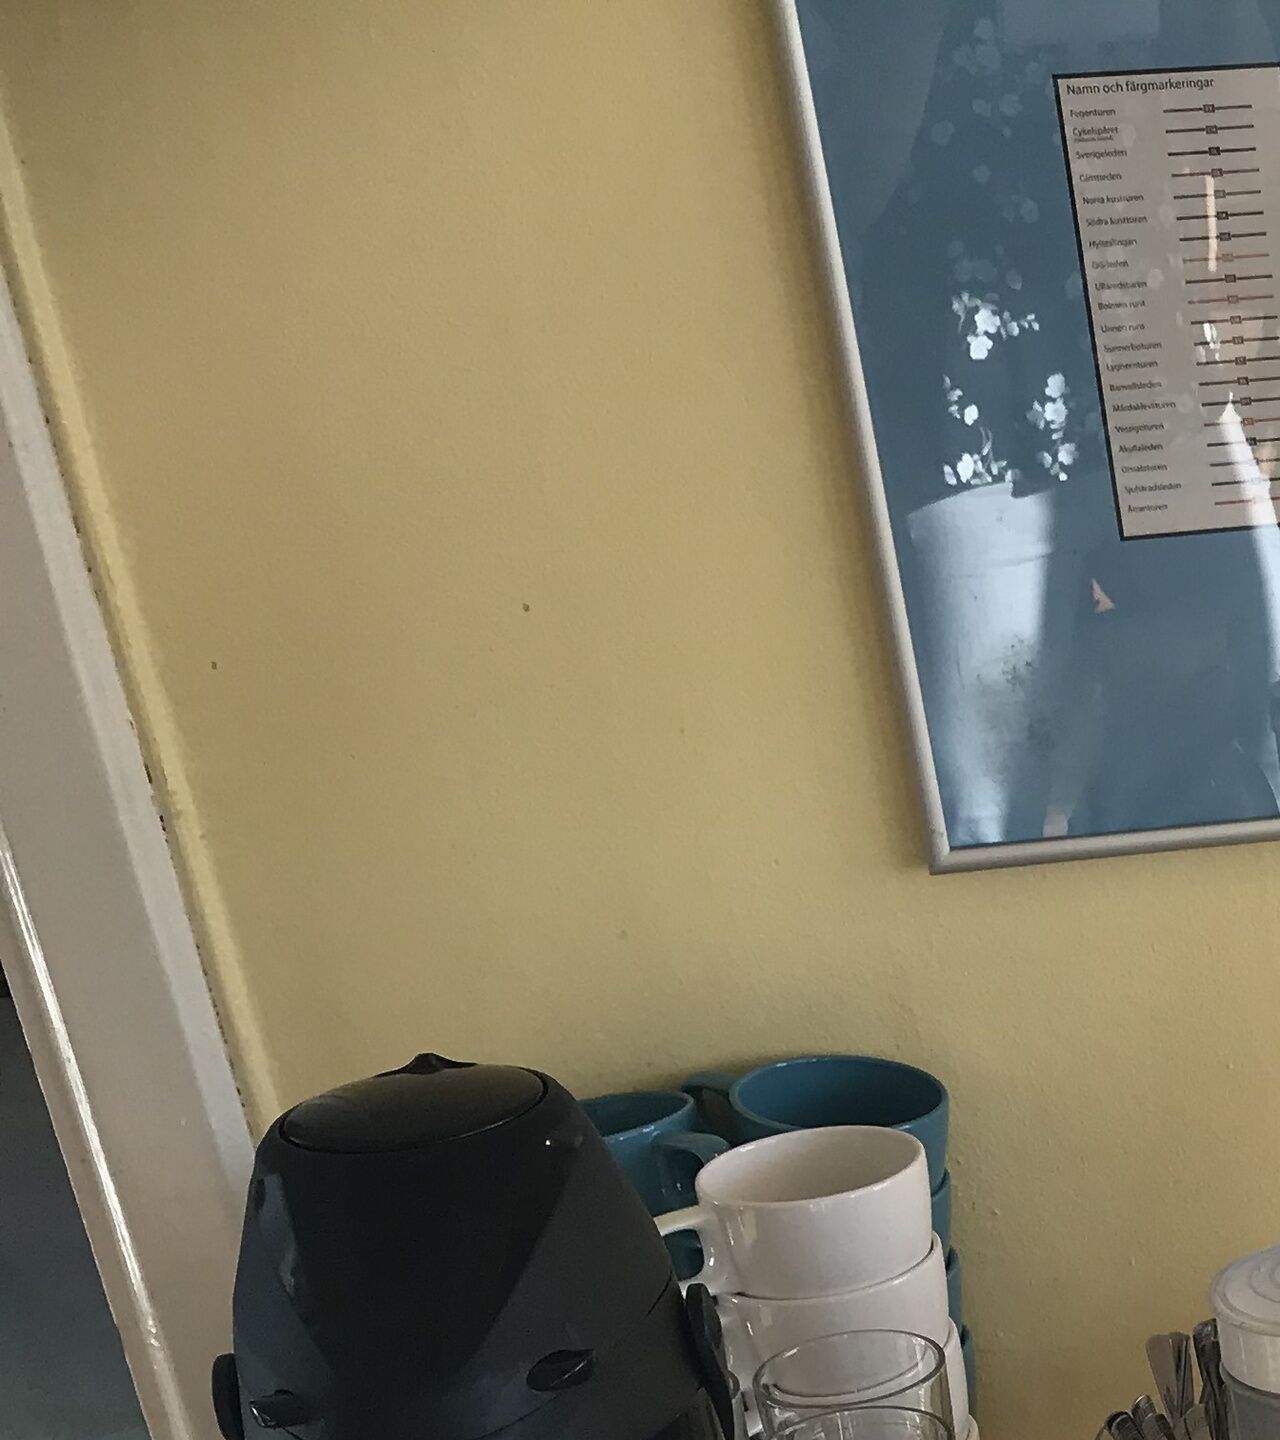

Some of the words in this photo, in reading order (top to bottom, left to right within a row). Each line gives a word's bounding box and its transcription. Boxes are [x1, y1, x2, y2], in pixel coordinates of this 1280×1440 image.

[1066, 84, 1100, 96] Namn
[1102, 82, 1124, 93] och
[1126, 77, 1215, 94] färgmarkeringar
